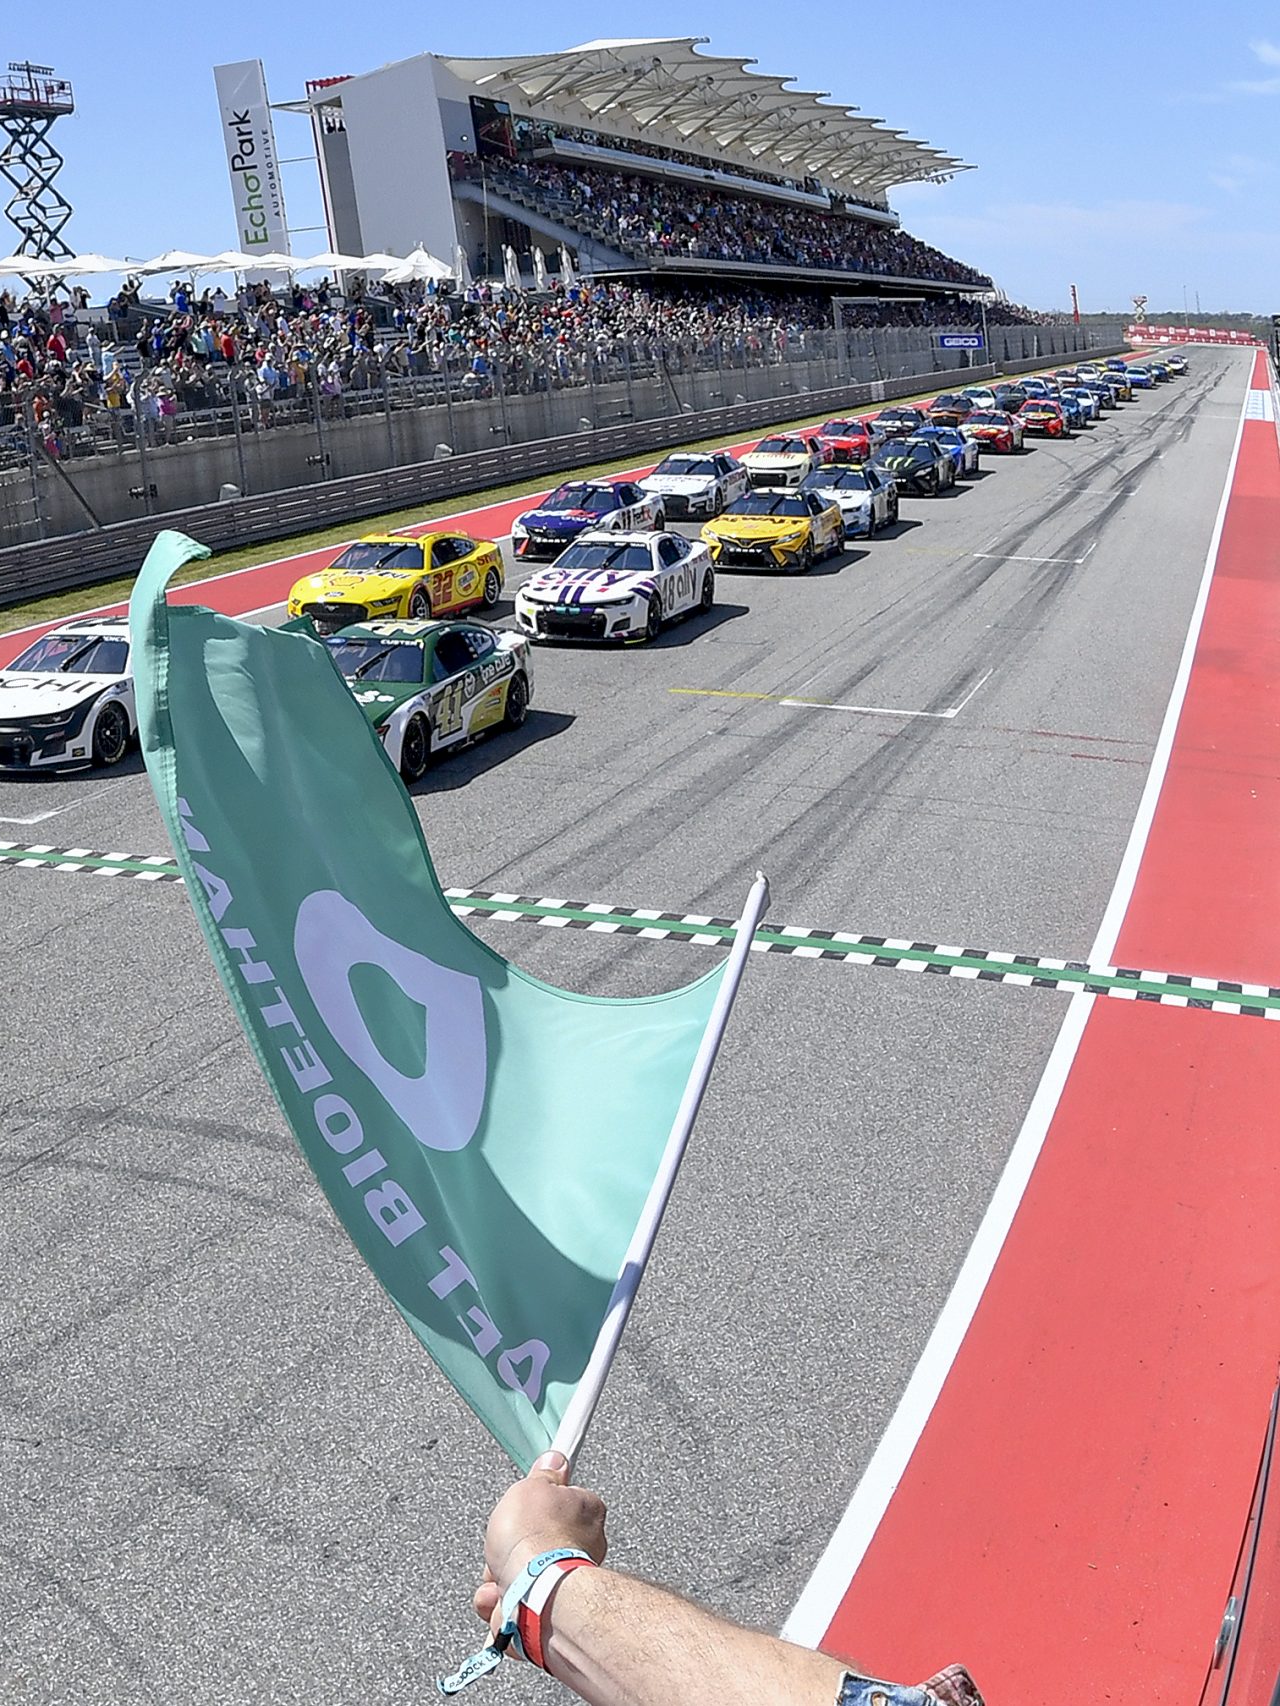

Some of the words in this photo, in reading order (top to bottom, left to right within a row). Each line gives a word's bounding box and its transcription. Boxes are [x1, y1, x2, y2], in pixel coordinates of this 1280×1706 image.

[228, 109, 269, 245] EchoPark
[262, 129, 281, 217] AUTOMOTIVE
[677, 563, 697, 600] ally
[435, 679, 463, 736] 41
[538, 1553, 557, 1567] DAY
